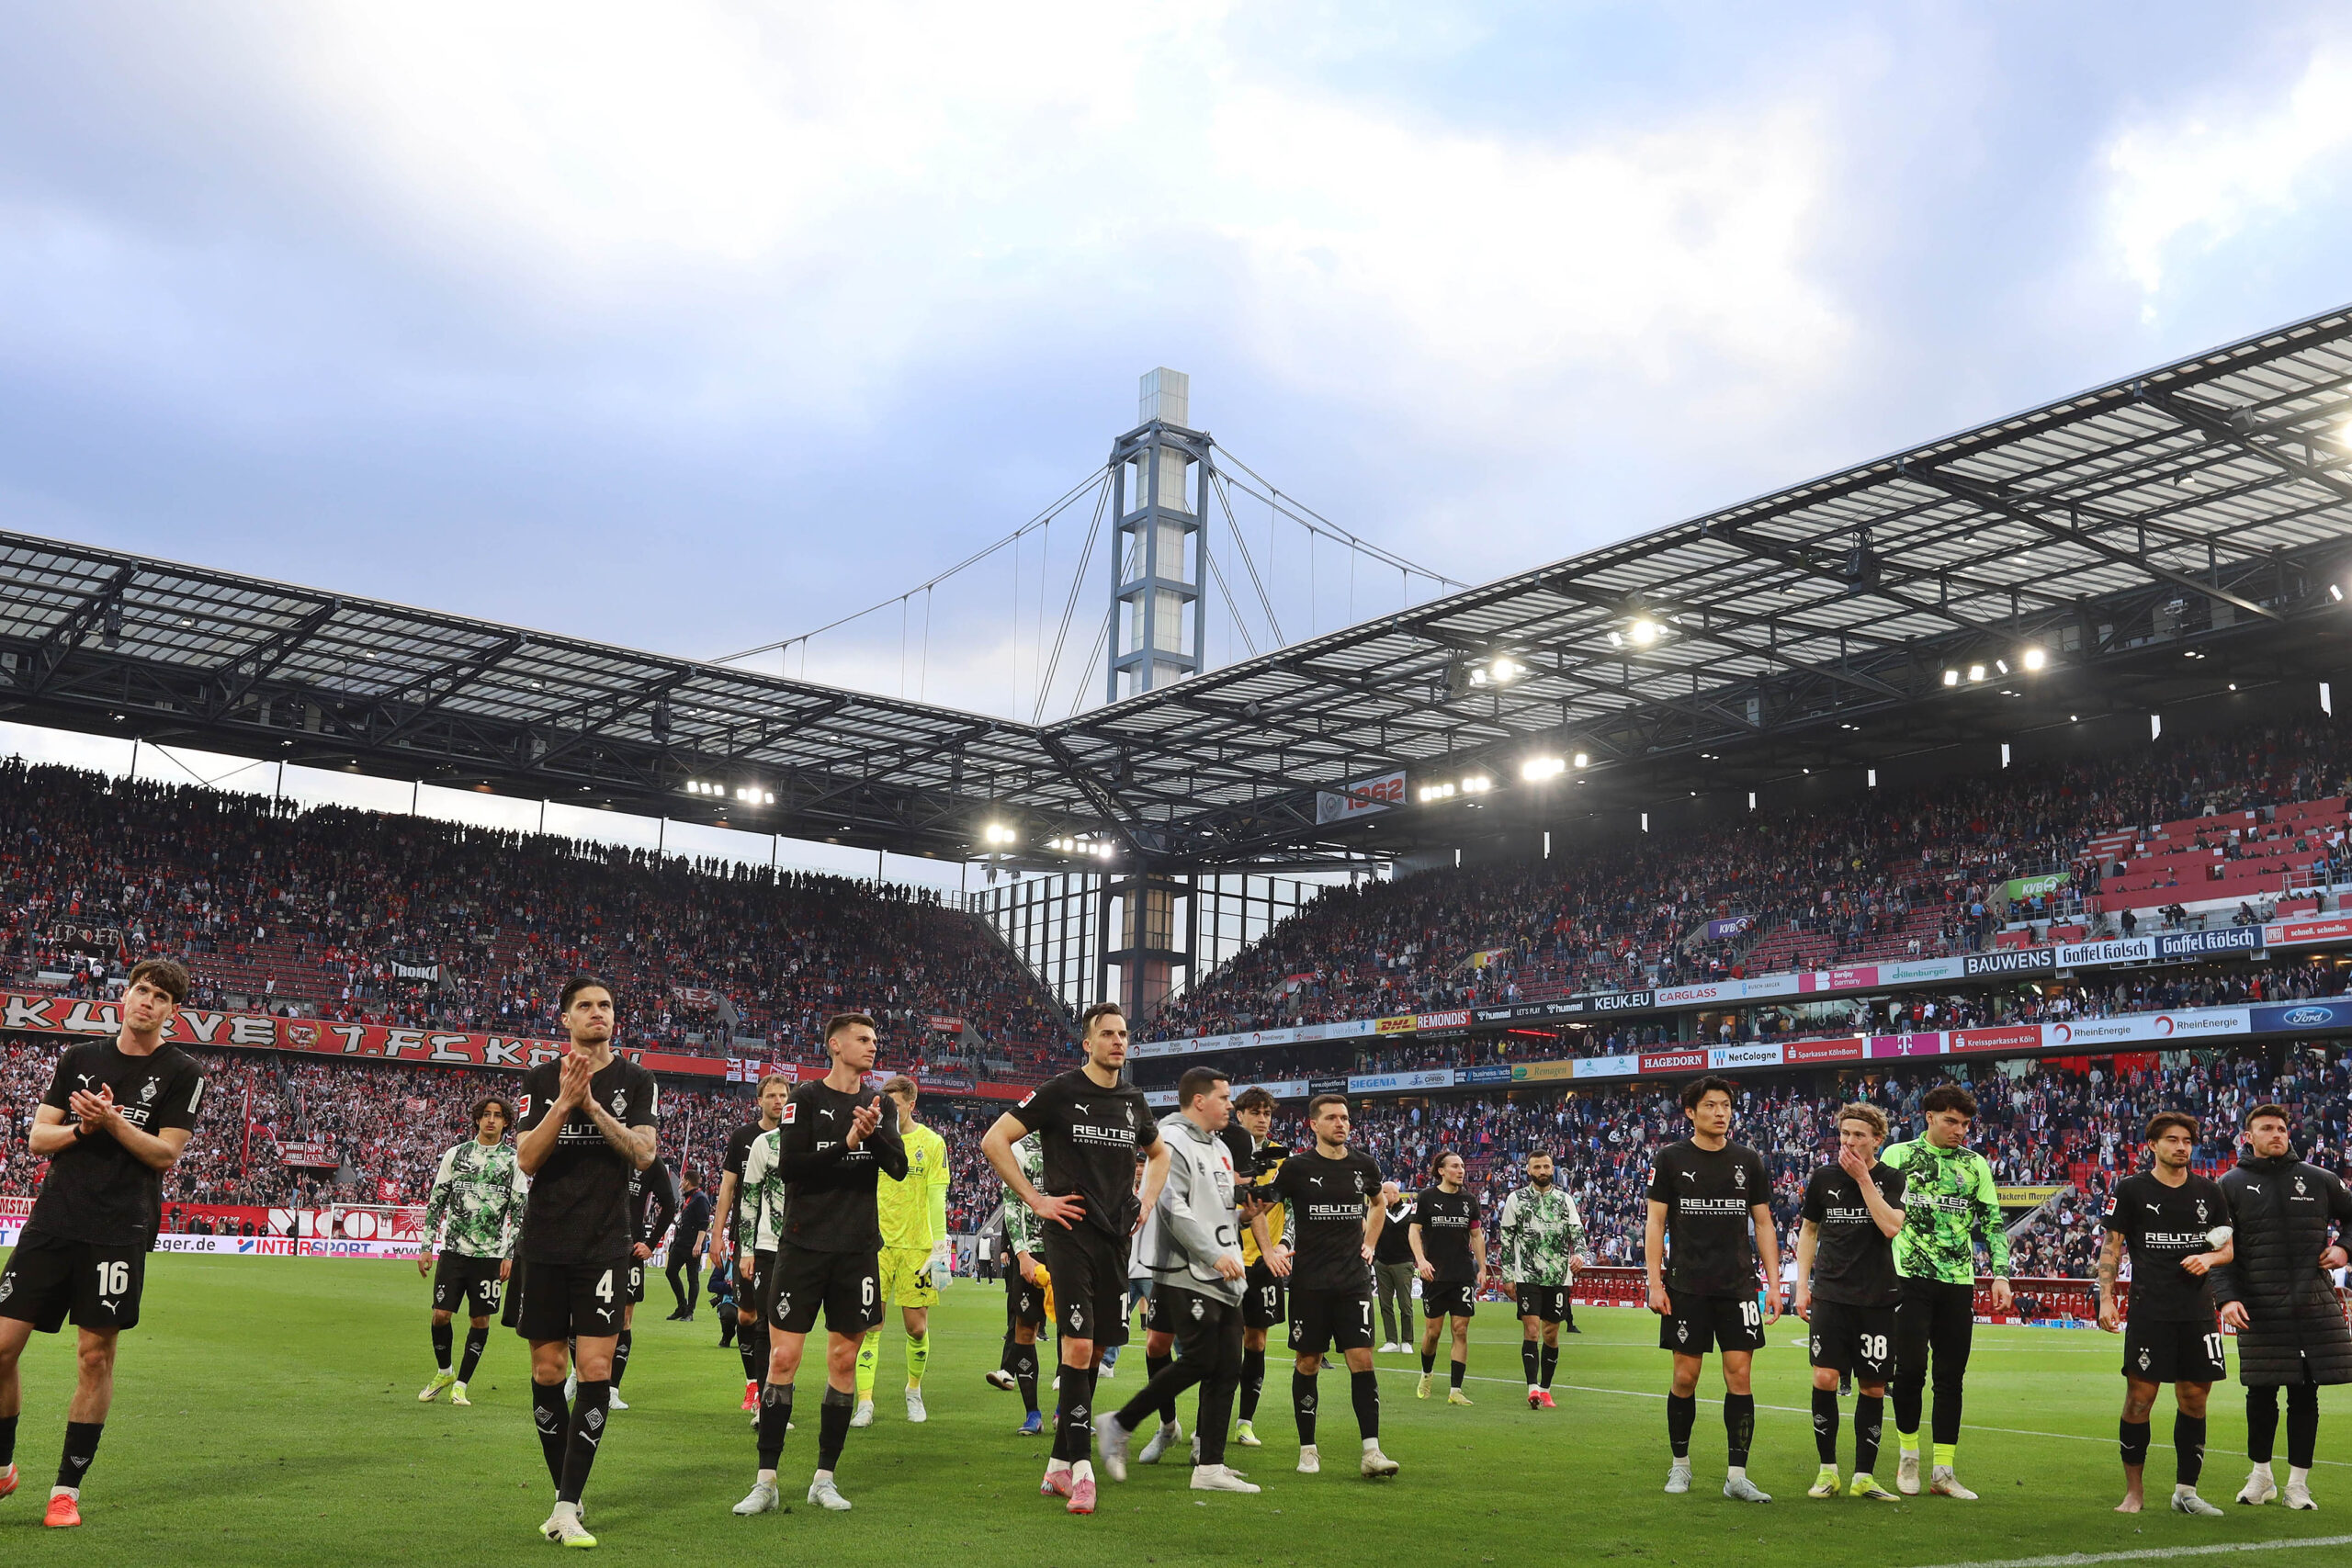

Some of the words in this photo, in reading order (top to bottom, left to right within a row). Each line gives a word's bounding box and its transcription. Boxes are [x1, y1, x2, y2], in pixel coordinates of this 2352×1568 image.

[1346, 778, 1404, 810] 1962
[2022, 882, 2041, 894] KVB
[1720, 921, 1736, 933] KVB
[2291, 928, 2315, 937] schnell.
[2317, 925, 2348, 934] schneller.
[2163, 933, 2205, 953] Gaffel
[2206, 928, 2255, 949] Kölsch
[2064, 946, 2102, 963] Gaffel
[2104, 940, 2148, 960] Kölsch
[1968, 950, 2052, 975] BAUWENS
[390, 960, 438, 983] TROIKA
[1834, 977, 1860, 987] Germany
[1659, 987, 1717, 1002] CARGLASS
[1555, 1001, 1583, 1013] hummel
[1595, 993, 1650, 1011] KEUK.EU
[1485, 1009, 1511, 1021] hummel
[1517, 1008, 1528, 1017] LET'S
[1528, 1007, 1541, 1015] PLAY
[2293, 1010, 2323, 1023] Ford
[1, 997, 277, 1047] KUVE
[1381, 1020, 1412, 1032] DHL
[2177, 1017, 2238, 1030] RheinEnergie
[2075, 1026, 2132, 1038] RheinEnergie
[1968, 1038, 2018, 1047] Kreissparkasse
[2019, 1035, 2035, 1044] Köln
[482, 1037, 642, 1068] KÖN
[1728, 1051, 1777, 1062] NetCologne
[1798, 1050, 1828, 1059] Sparkasse
[1829, 1047, 1858, 1056] KölnBonn
[1645, 1055, 1702, 1068] HAGEDORN
[1534, 1066, 1566, 1077] Remagen
[919, 1077, 941, 1086] WILDER
[944, 1078, 965, 1087] SÜDEN
[1350, 1077, 1397, 1089] SIEGENIA
[1072, 1123, 1136, 1142] REUTER
[455, 1181, 506, 1192] REUTER
[1308, 1203, 1363, 1214] REUTER
[1680, 1198, 1747, 1208] REUTER
[1826, 1207, 1871, 1217] REUTE
[1430, 1215, 1470, 1224] REUTER
[2145, 1232, 2207, 1242] REUTER
[256, 1239, 371, 1254] INTERSPORT
[96, 1260, 130, 1297] 16
[628, 1267, 641, 1286] 6
[480, 1279, 502, 1300] 36
[595, 1269, 614, 1304] 4
[861, 1276, 875, 1306] 6
[1261, 1285, 1277, 1309] 13
[1555, 1292, 1563, 1308] 9
[1359, 1300, 1371, 1325] 7
[1738, 1300, 1760, 1326] 18
[2006, 1317, 2022, 1325] REW
[1860, 1333, 1888, 1360] 38
[2202, 1332, 2223, 1359] 17
